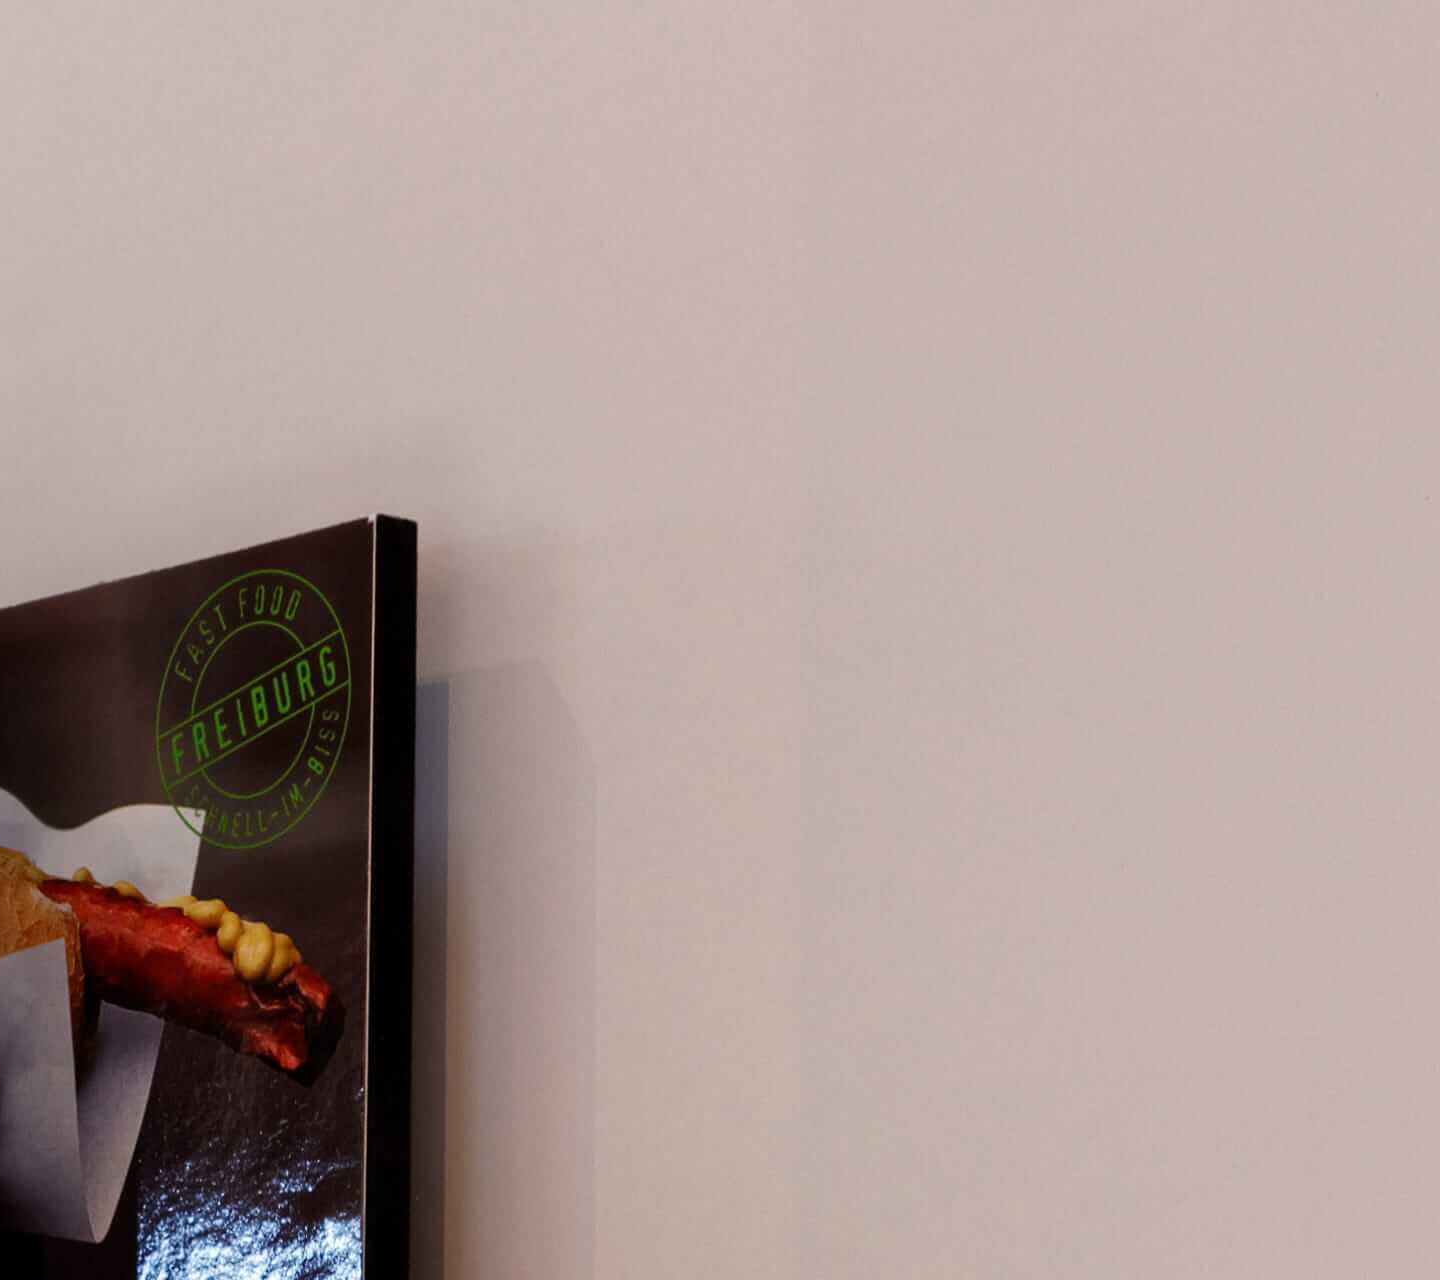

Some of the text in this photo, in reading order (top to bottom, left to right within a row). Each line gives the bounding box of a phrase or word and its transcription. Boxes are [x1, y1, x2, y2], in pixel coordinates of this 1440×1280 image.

[175, 584, 302, 682] FAST FOOD
[171, 646, 337, 774] FREIBURG
